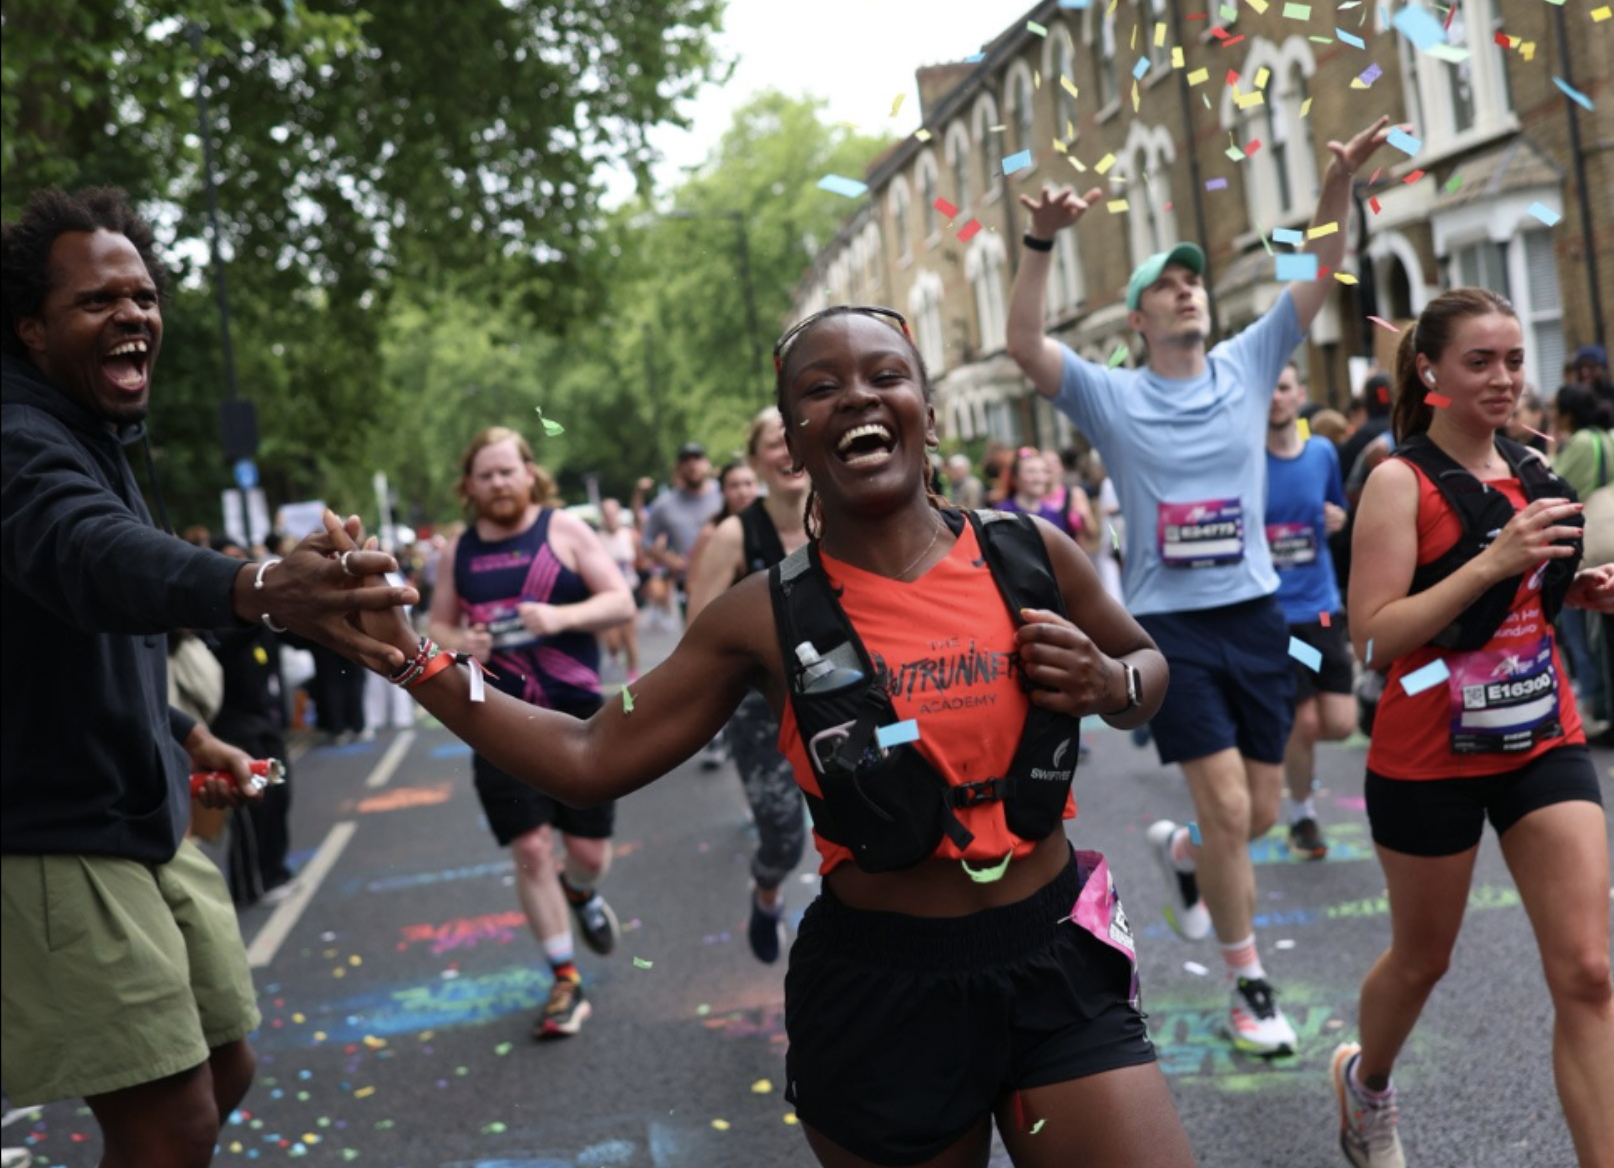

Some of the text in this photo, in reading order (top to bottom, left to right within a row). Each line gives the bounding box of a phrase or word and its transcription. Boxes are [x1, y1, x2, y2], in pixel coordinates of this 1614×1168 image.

[928, 636, 960, 651] THE
[1488, 673, 1551, 700] E16300
[919, 694, 997, 714] ACADEMY
